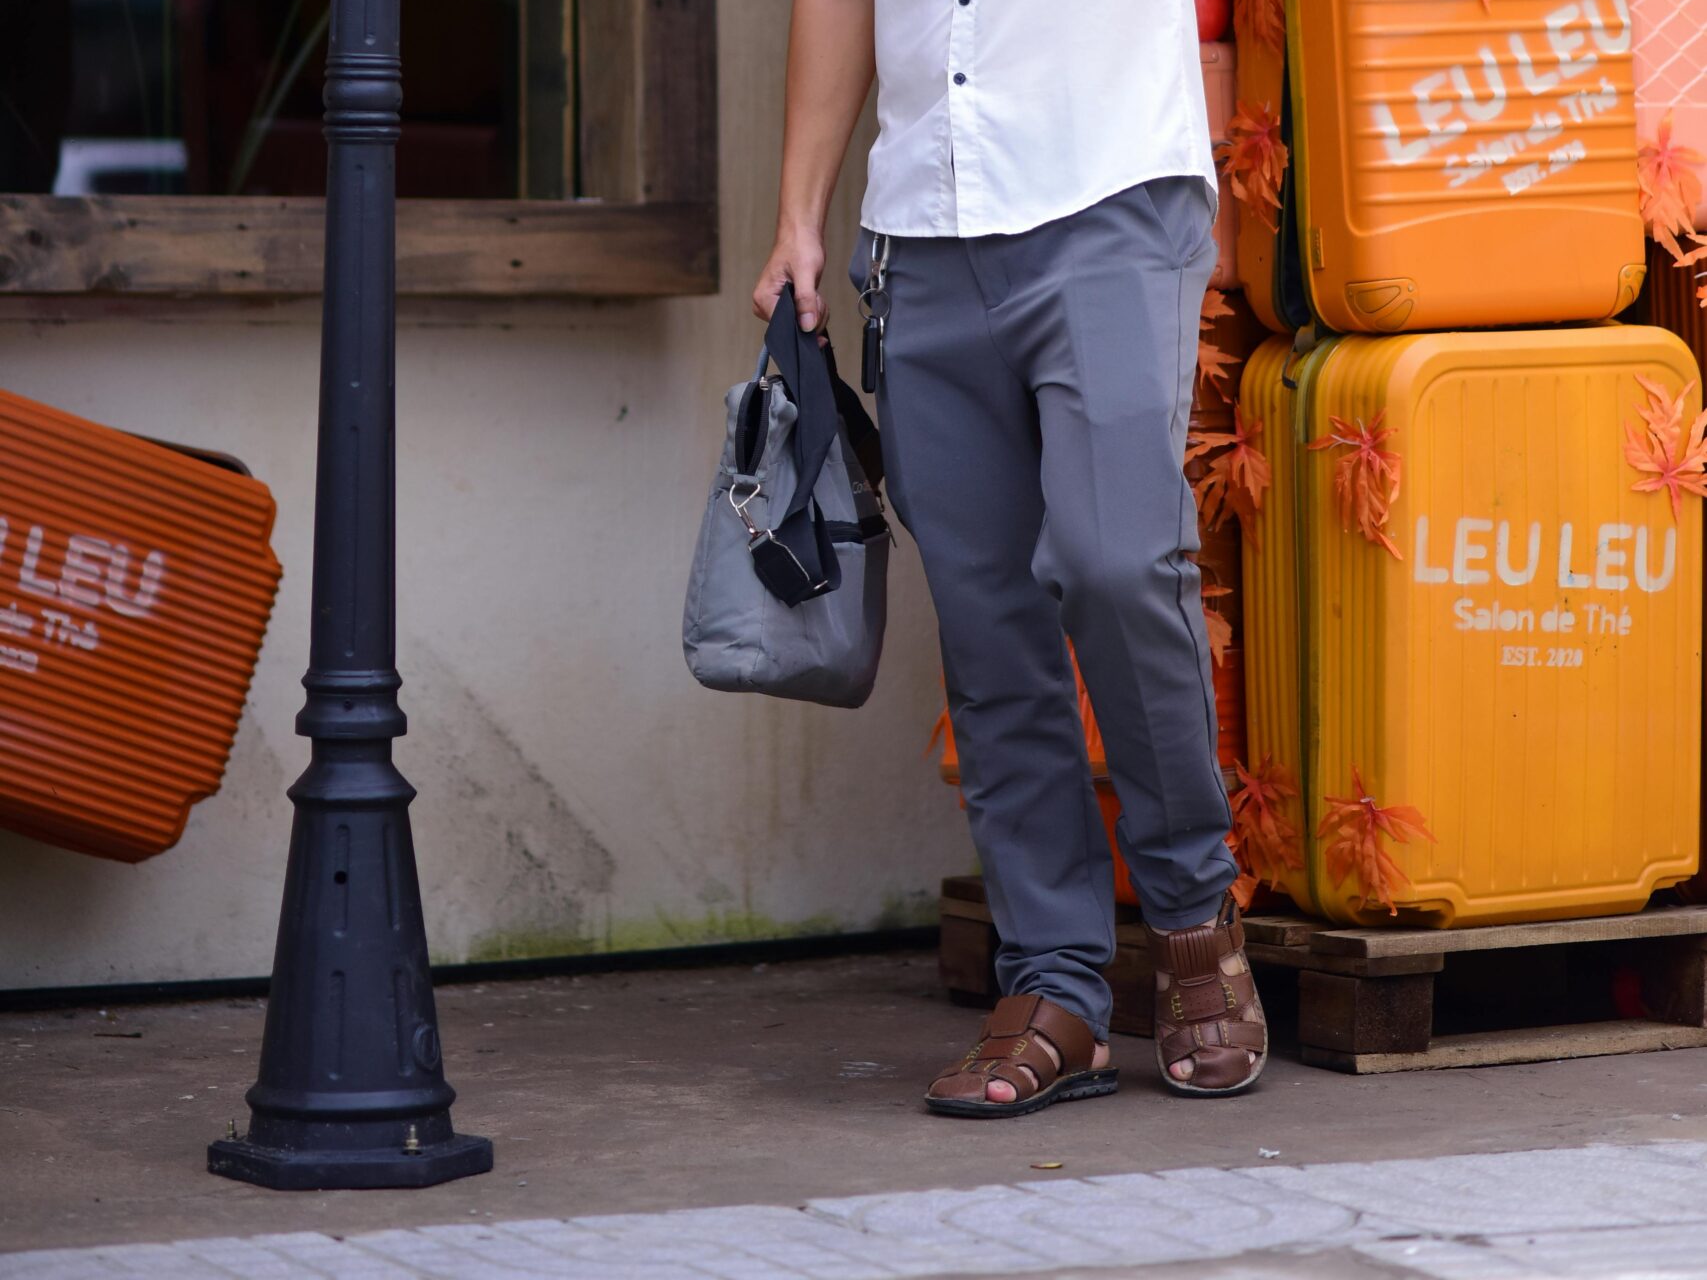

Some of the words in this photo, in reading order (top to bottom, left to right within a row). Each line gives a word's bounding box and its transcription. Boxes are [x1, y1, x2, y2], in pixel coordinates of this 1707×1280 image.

[1371, 47, 1507, 165] LEU
[17, 525, 165, 619] LEU
[1413, 514, 1541, 586] LEU
[1557, 522, 1677, 592] LEU
[1452, 597, 1534, 632] Salon
[1540, 603, 1576, 633] de
[1582, 603, 1633, 635] Thé
[1500, 645, 1543, 666] EST.
